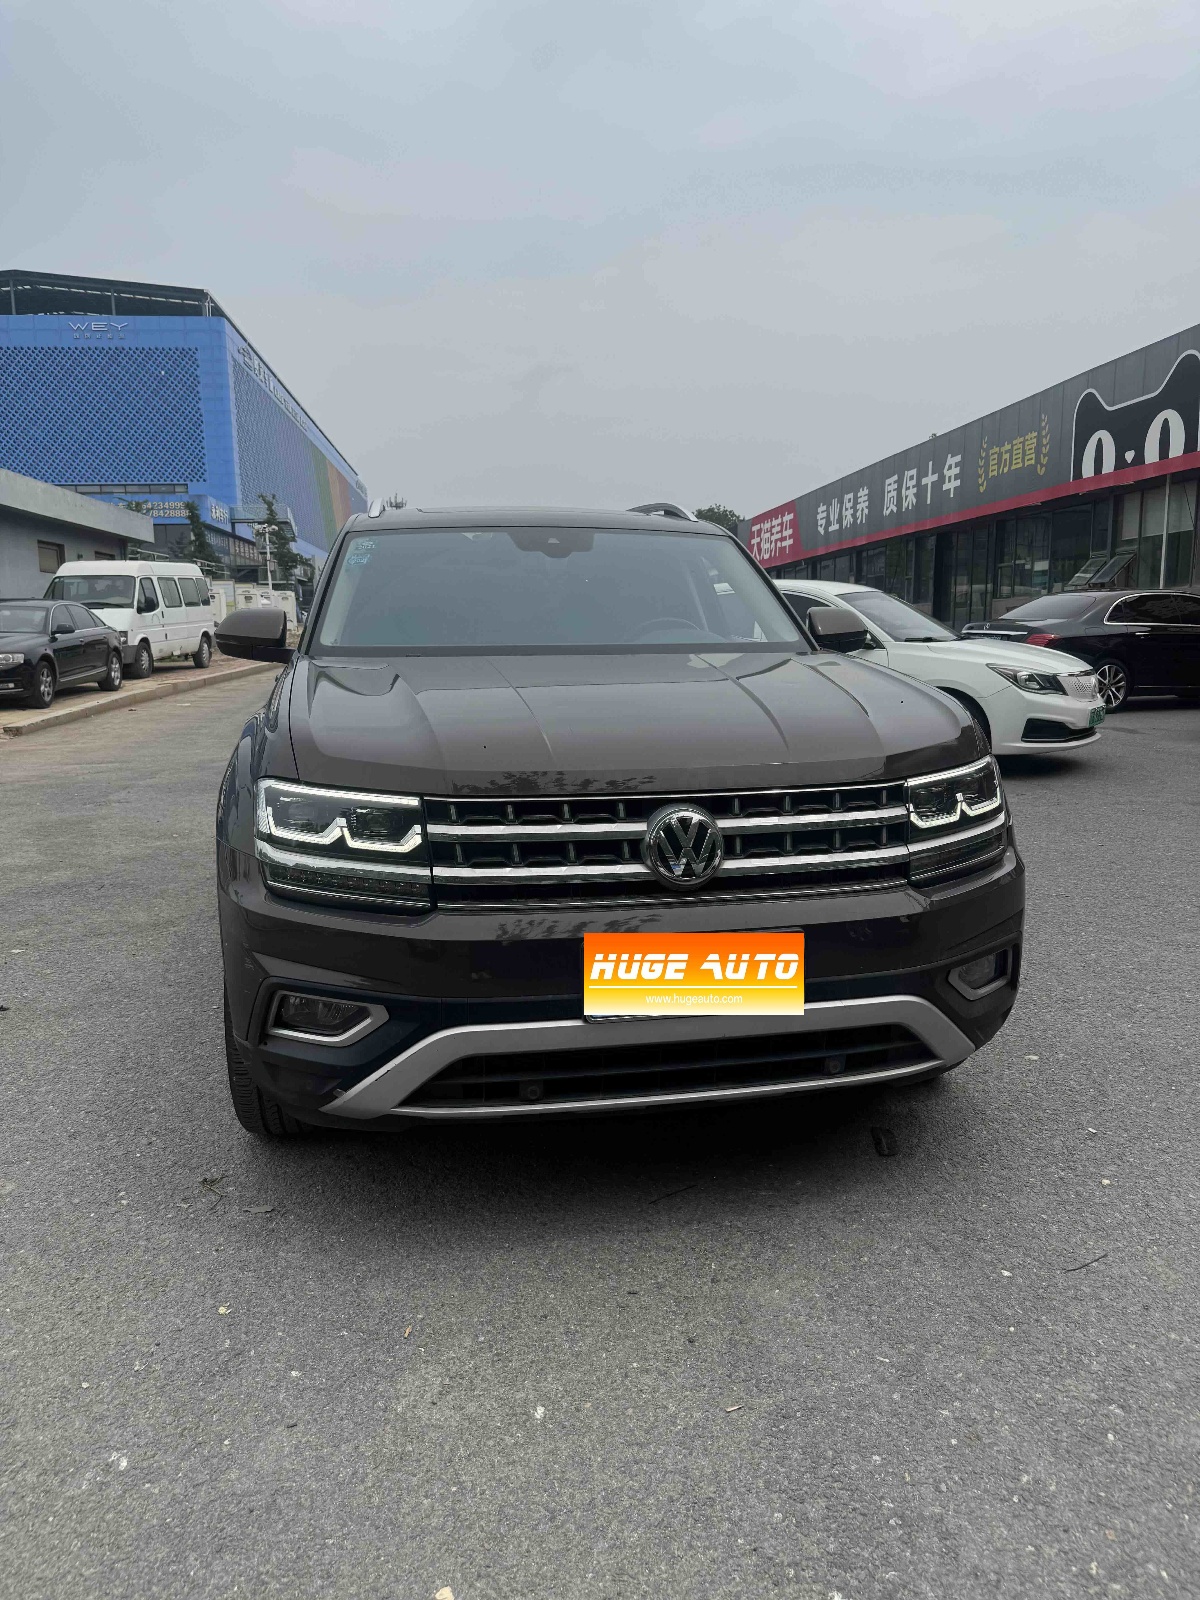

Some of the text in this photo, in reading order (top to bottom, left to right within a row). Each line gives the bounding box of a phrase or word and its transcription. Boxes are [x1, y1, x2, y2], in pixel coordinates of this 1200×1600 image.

[68, 321, 129, 331] WEY
[988, 430, 1038, 479] 官方直营
[816, 453, 962, 536] 专业保养 质保十年
[751, 511, 794, 561] 天猫养车
